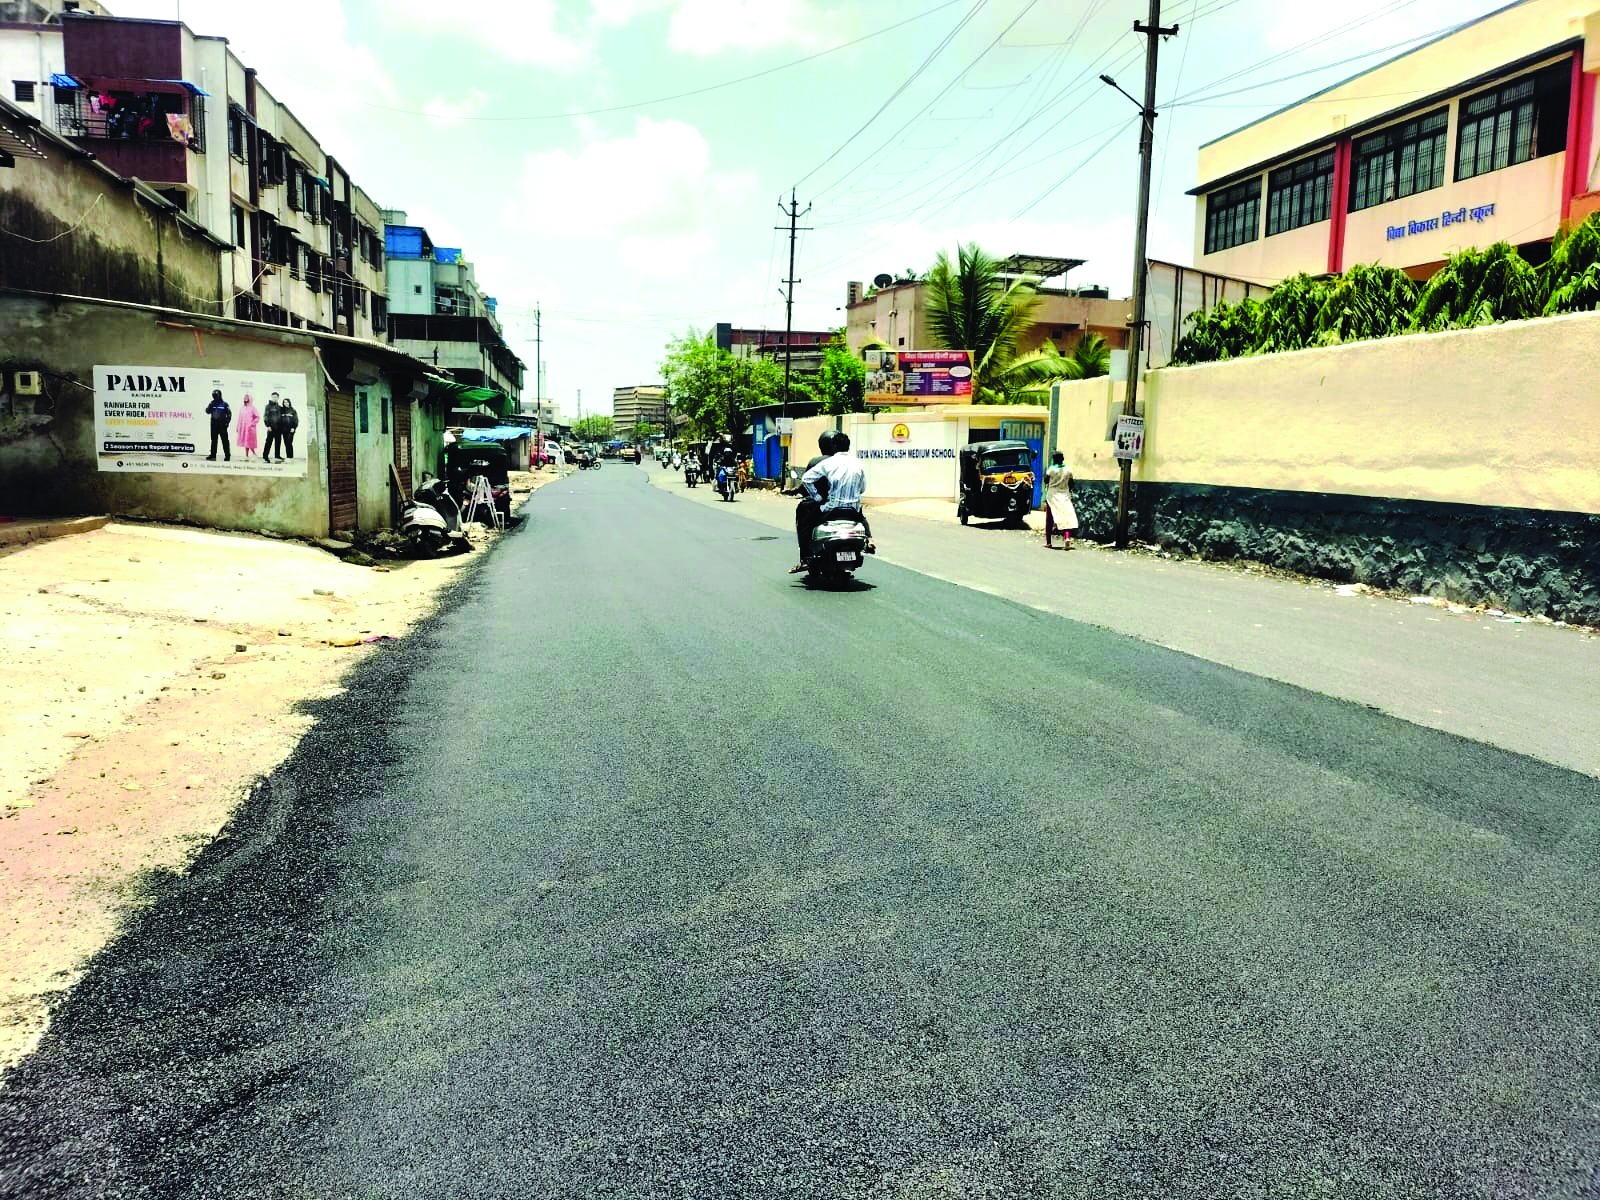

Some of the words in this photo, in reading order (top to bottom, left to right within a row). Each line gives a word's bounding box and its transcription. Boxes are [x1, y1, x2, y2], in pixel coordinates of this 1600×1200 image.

[1408, 218, 1439, 235] विकास
[1442, 207, 1467, 227] हिन्दी
[1469, 203, 1496, 223] स्कूल
[106, 374, 186, 393] PADAM
[103, 401, 137, 409] RAINWEAR
[126, 410, 147, 419] RIDER,
[856, 449, 869, 459] VIDYA
[869, 449, 884, 459] VIKAS
[884, 449, 907, 458] ENGLISH
[908, 448, 930, 458] MEDIUM
[931, 448, 956, 458] SCHOOL
